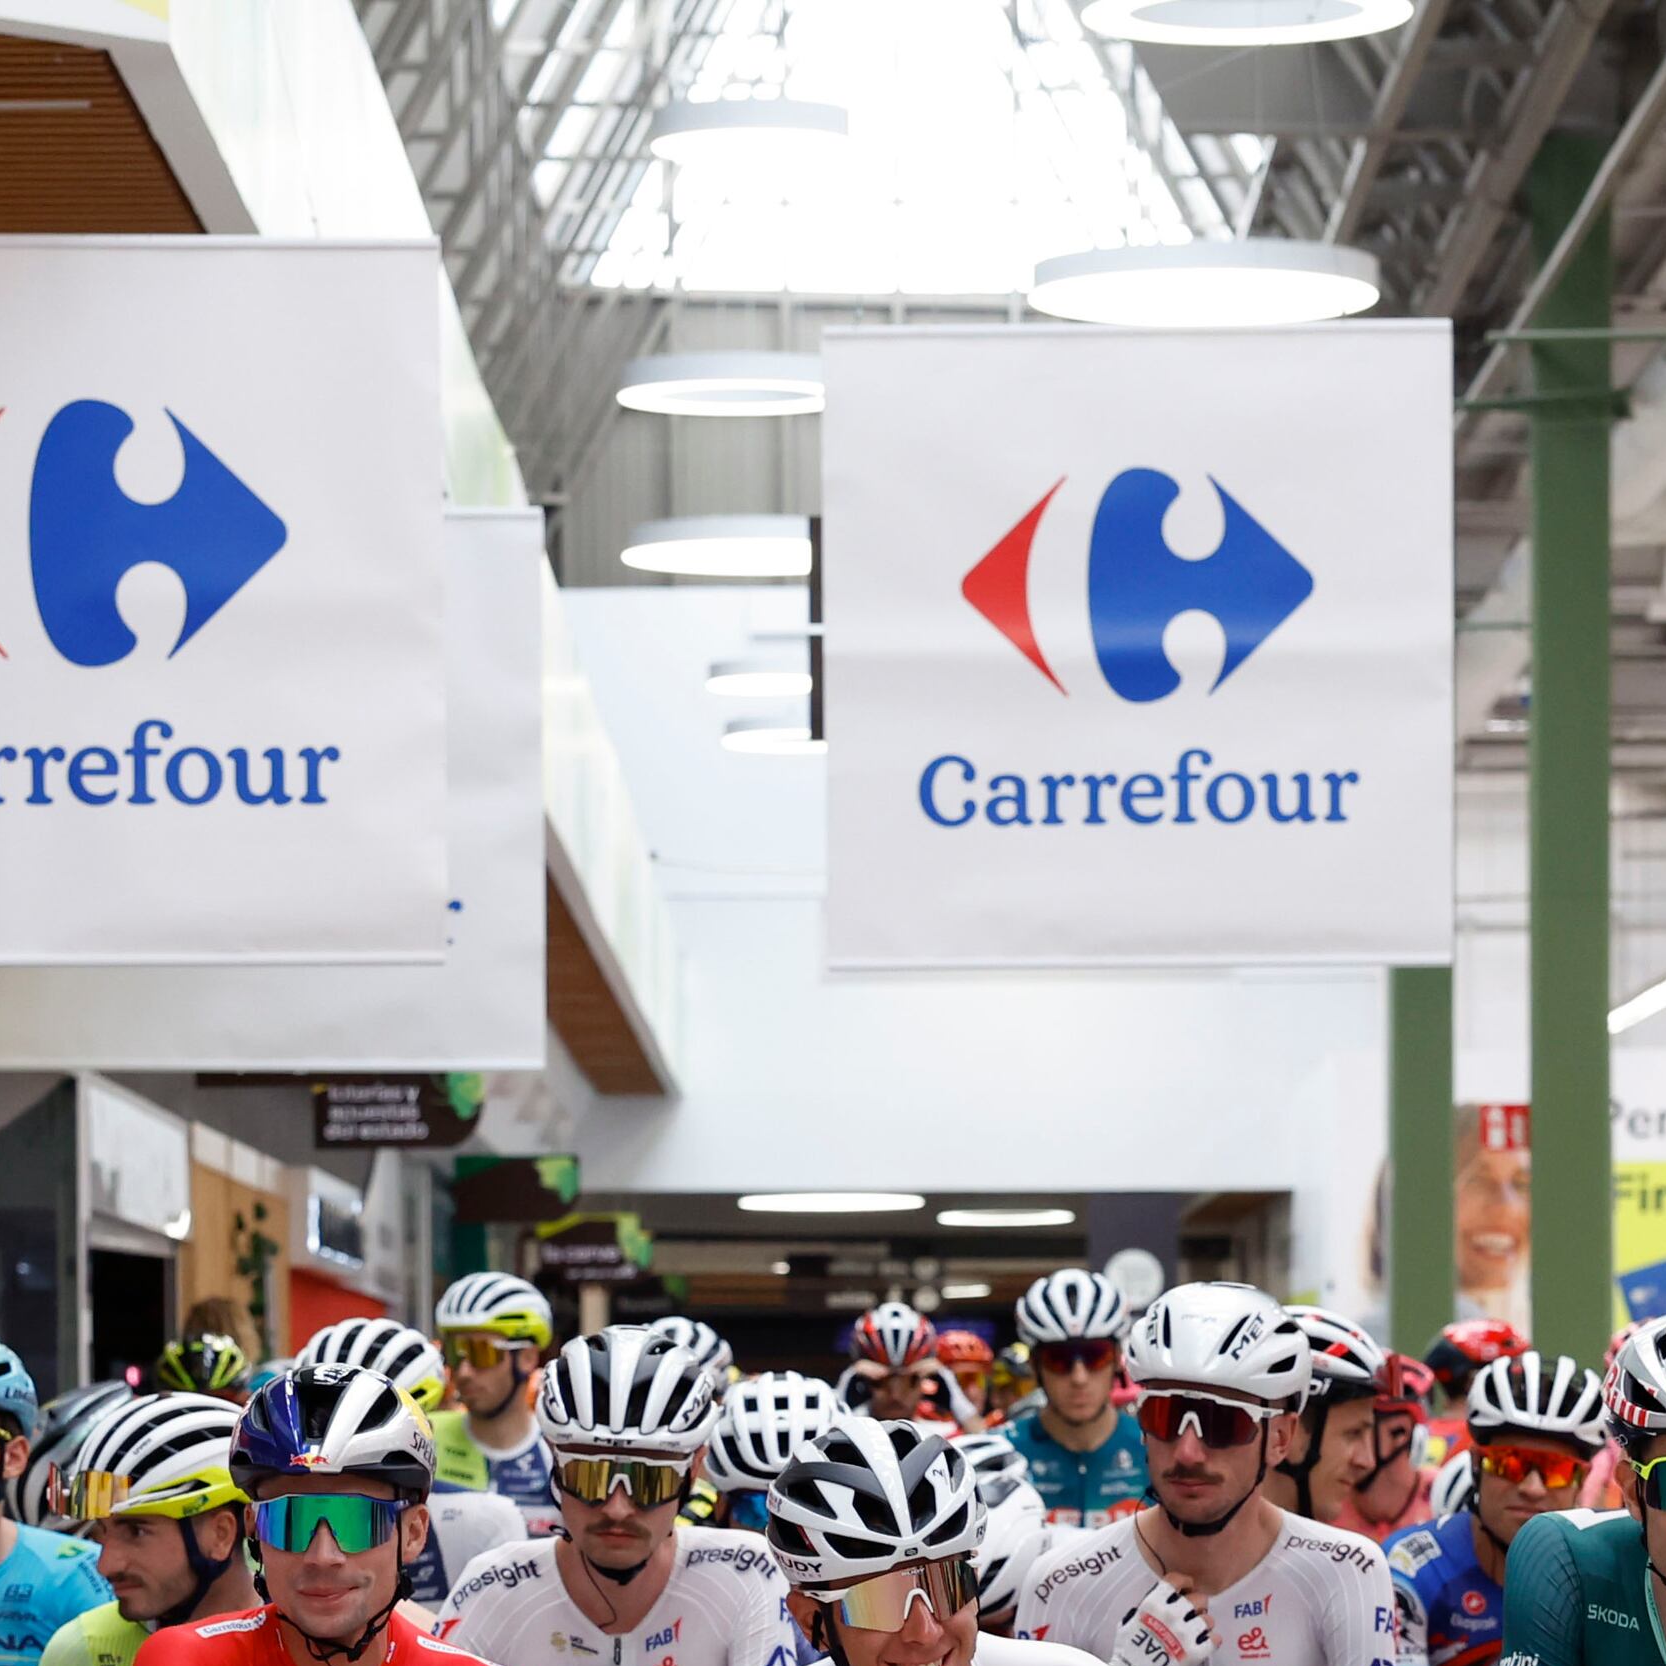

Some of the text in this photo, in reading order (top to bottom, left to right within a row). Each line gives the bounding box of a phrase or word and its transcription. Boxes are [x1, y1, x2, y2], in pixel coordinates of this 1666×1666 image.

[919, 749, 1360, 827] Carrefour
[1232, 1312, 1265, 1360] MET
[686, 1546, 777, 1579] presight
[1034, 1544, 1122, 1604] presight
[1285, 1535, 1376, 1574] presight
[451, 1559, 541, 1609] presight
